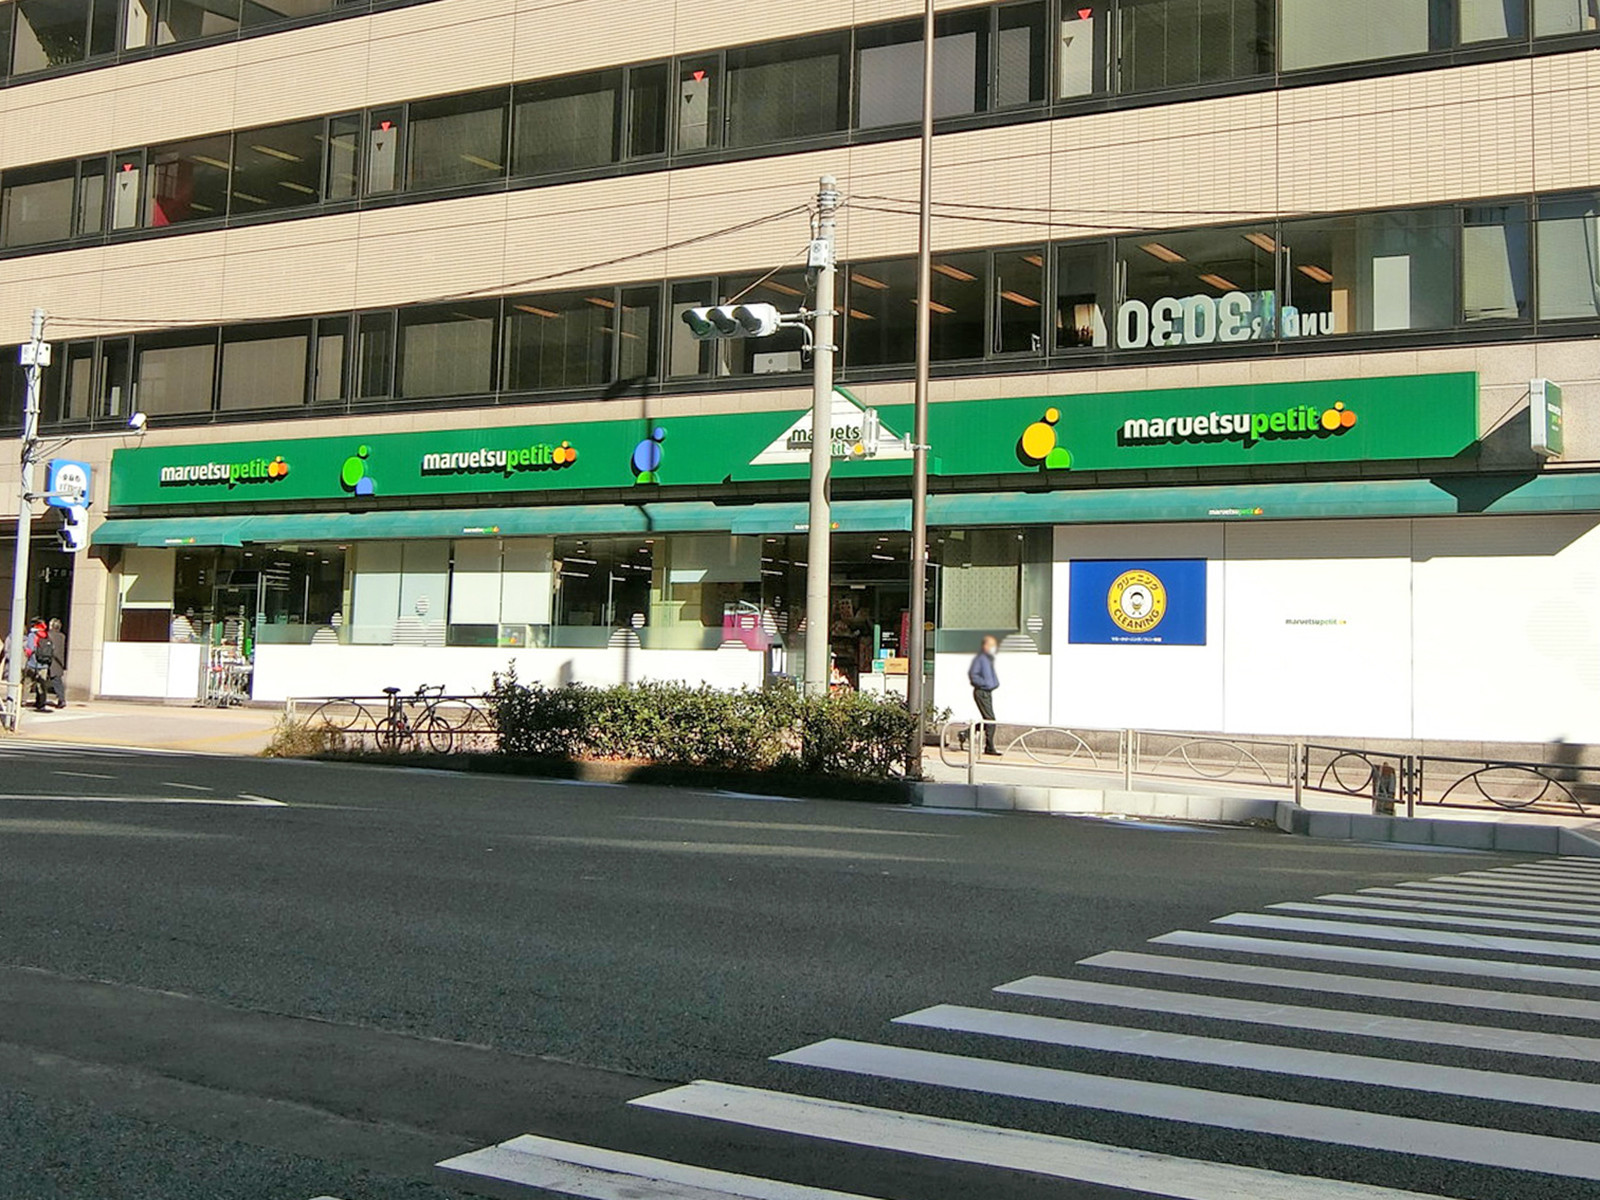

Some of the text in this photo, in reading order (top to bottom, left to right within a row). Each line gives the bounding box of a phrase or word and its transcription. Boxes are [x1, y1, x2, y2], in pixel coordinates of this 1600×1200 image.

[1123, 406, 1319, 440] maruetsupetit
[424, 444, 552, 471] maruetsupetit
[161, 458, 267, 485] maruetsupetit
[1116, 574, 1159, 591] クリーニング
[1113, 608, 1160, 629] CLEANING
